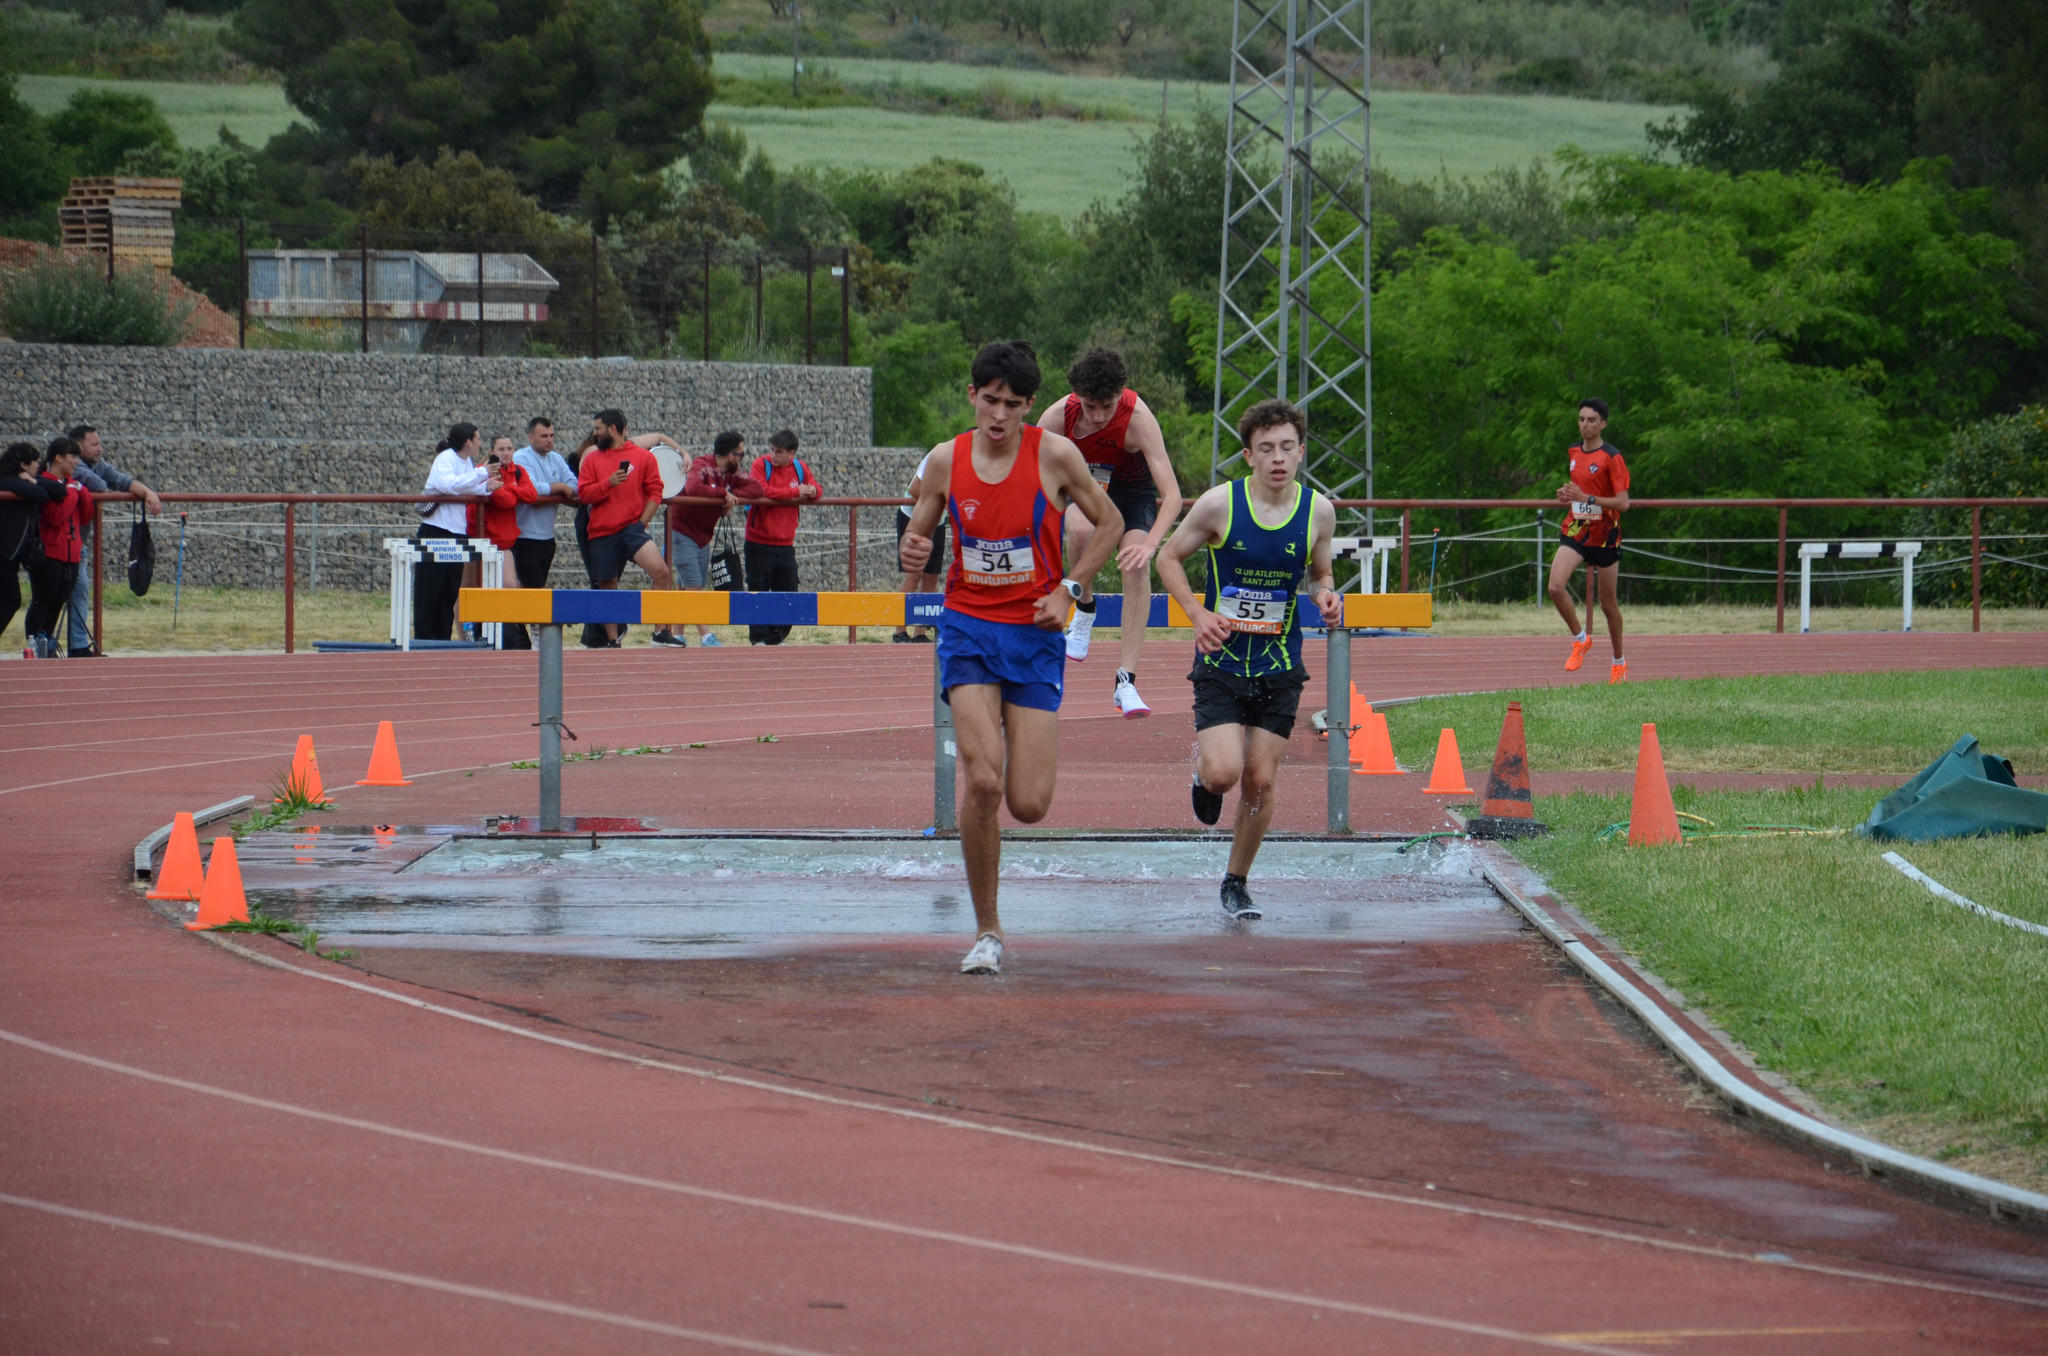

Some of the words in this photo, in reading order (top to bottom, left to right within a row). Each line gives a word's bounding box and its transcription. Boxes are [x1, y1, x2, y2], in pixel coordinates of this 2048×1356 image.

[1580, 503, 1591, 513] 66
[439, 553, 463, 561] MONDO
[982, 552, 1013, 572] 54
[968, 572, 1031, 585] mutuacat
[1234, 567, 1253, 576] CLUB
[1255, 570, 1293, 579] ATLETISME
[1242, 577, 1262, 586] SANT
[1263, 578, 1281, 587] JUST
[1236, 600, 1266, 620] 55
[1232, 621, 1277, 633] utuacat
